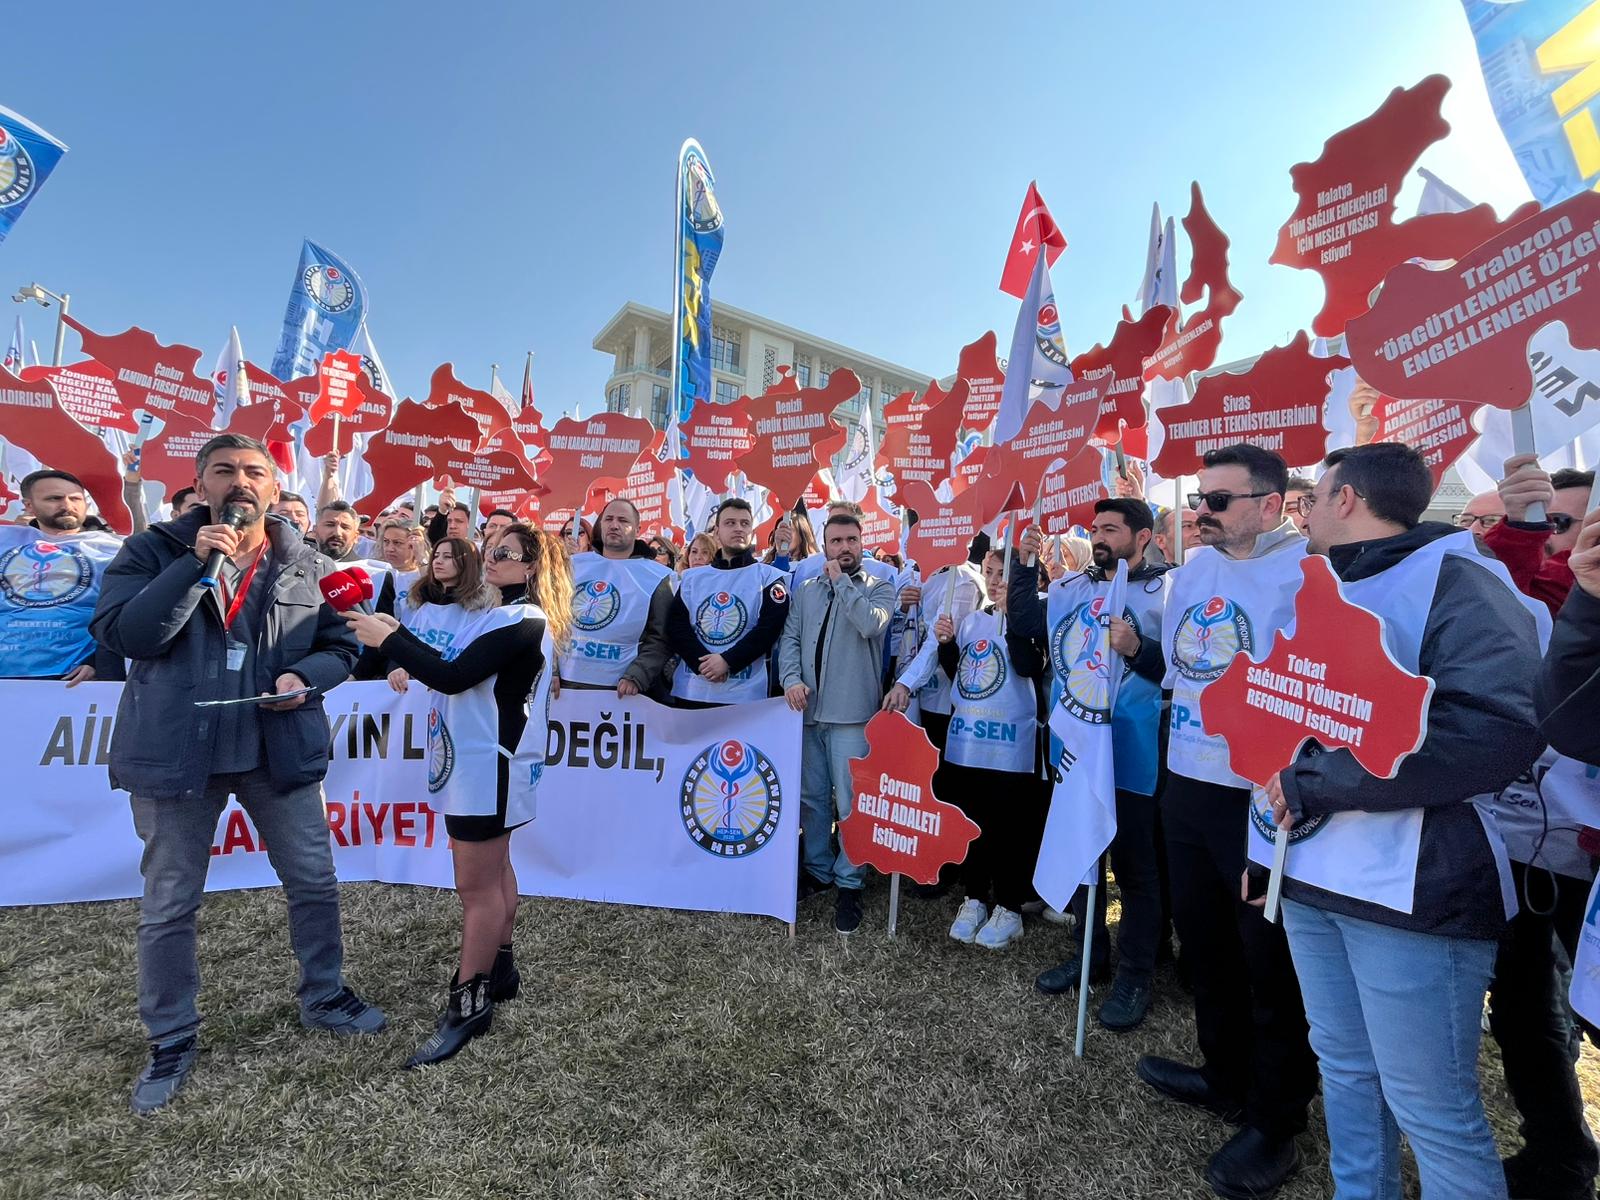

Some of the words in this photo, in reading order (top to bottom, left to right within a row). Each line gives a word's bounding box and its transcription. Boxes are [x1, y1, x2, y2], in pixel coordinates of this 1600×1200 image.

[1317, 182, 1352, 208] Malatya
[1289, 220, 1306, 238] TÜM
[1307, 209, 1336, 232] SAĞLIK
[1337, 183, 1388, 218] EMEKÇİLERİ
[1297, 235, 1314, 255] İÇİN
[1315, 224, 1346, 248] MESLEK
[1346, 210, 1378, 237] YASASI
[1321, 240, 1352, 265] istiyor!
[1460, 215, 1573, 290] Trabzon
[1374, 264, 1536, 362] “ÖRGÜTLENME
[1402, 263, 1589, 379] ENGELLENEMEZ”
[155, 362, 184, 381] Çankırı
[118, 368, 152, 388] KAMUDA
[152, 378, 180, 396] FIRSAT
[179, 387, 211, 405] EŞİTLİĞİ
[1066, 388, 1098, 406] Şırnak
[145, 392, 176, 410] istiyor!
[775, 398, 802, 414] Denizli
[1223, 395, 1251, 413] Sivas
[587, 421, 606, 435] Artvin
[694, 426, 718, 437] KANUN
[719, 427, 748, 438] TANIMAZ
[711, 415, 732, 425] Konya
[756, 418, 782, 437] ÇÜRÜK
[782, 413, 825, 431] BİNALARDA
[1029, 420, 1063, 437] SAĞLIĞIN
[1169, 418, 1209, 440] TEKNİKER
[1211, 418, 1222, 434] VE
[1223, 403, 1317, 432] TEKNİSYENLERİNİN
[1396, 405, 1461, 443] SAYILARIN
[550, 435, 567, 449] YARGI
[568, 437, 600, 451] KARARLARI
[601, 438, 640, 454] UYGULANSIN
[691, 437, 733, 448] İDARECİLERE
[733, 439, 750, 449] CEZA
[772, 432, 811, 453] ÇALIŞMAK
[1011, 425, 1084, 451] ÖZELLEŞTİRİLMESİNİ
[1023, 442, 1068, 459] reddediyor!
[580, 454, 604, 469] istiyor!
[707, 450, 733, 461] istiyor!
[772, 450, 812, 468] istemiyor!
[464, 463, 492, 474] ÇALIŞMA
[1046, 474, 1065, 492] Aydın
[328, 582, 355, 598] DHA
[1288, 654, 1327, 680] Tokat
[1246, 666, 1303, 699] SAĞLIKTA
[1306, 683, 1373, 722] YÖNETİM
[950, 717, 1017, 742] EP-SEN
[1246, 688, 1304, 724] REFORMU
[1305, 708, 1364, 747] istiyor!
[40, 704, 113, 766] AİL
[326, 702, 390, 761] YİN
[545, 711, 665, 783] DEĞİL,
[880, 773, 921, 804] Çorum
[683, 757, 707, 842] HEP-SEN
[711, 841, 747, 855] HEP
[755, 759, 781, 845] SENİNLE
[858, 792, 889, 821] GELİR
[891, 802, 941, 836] ADALETİ
[326, 790, 436, 848] RİYET
[872, 823, 918, 857] istiyor!
